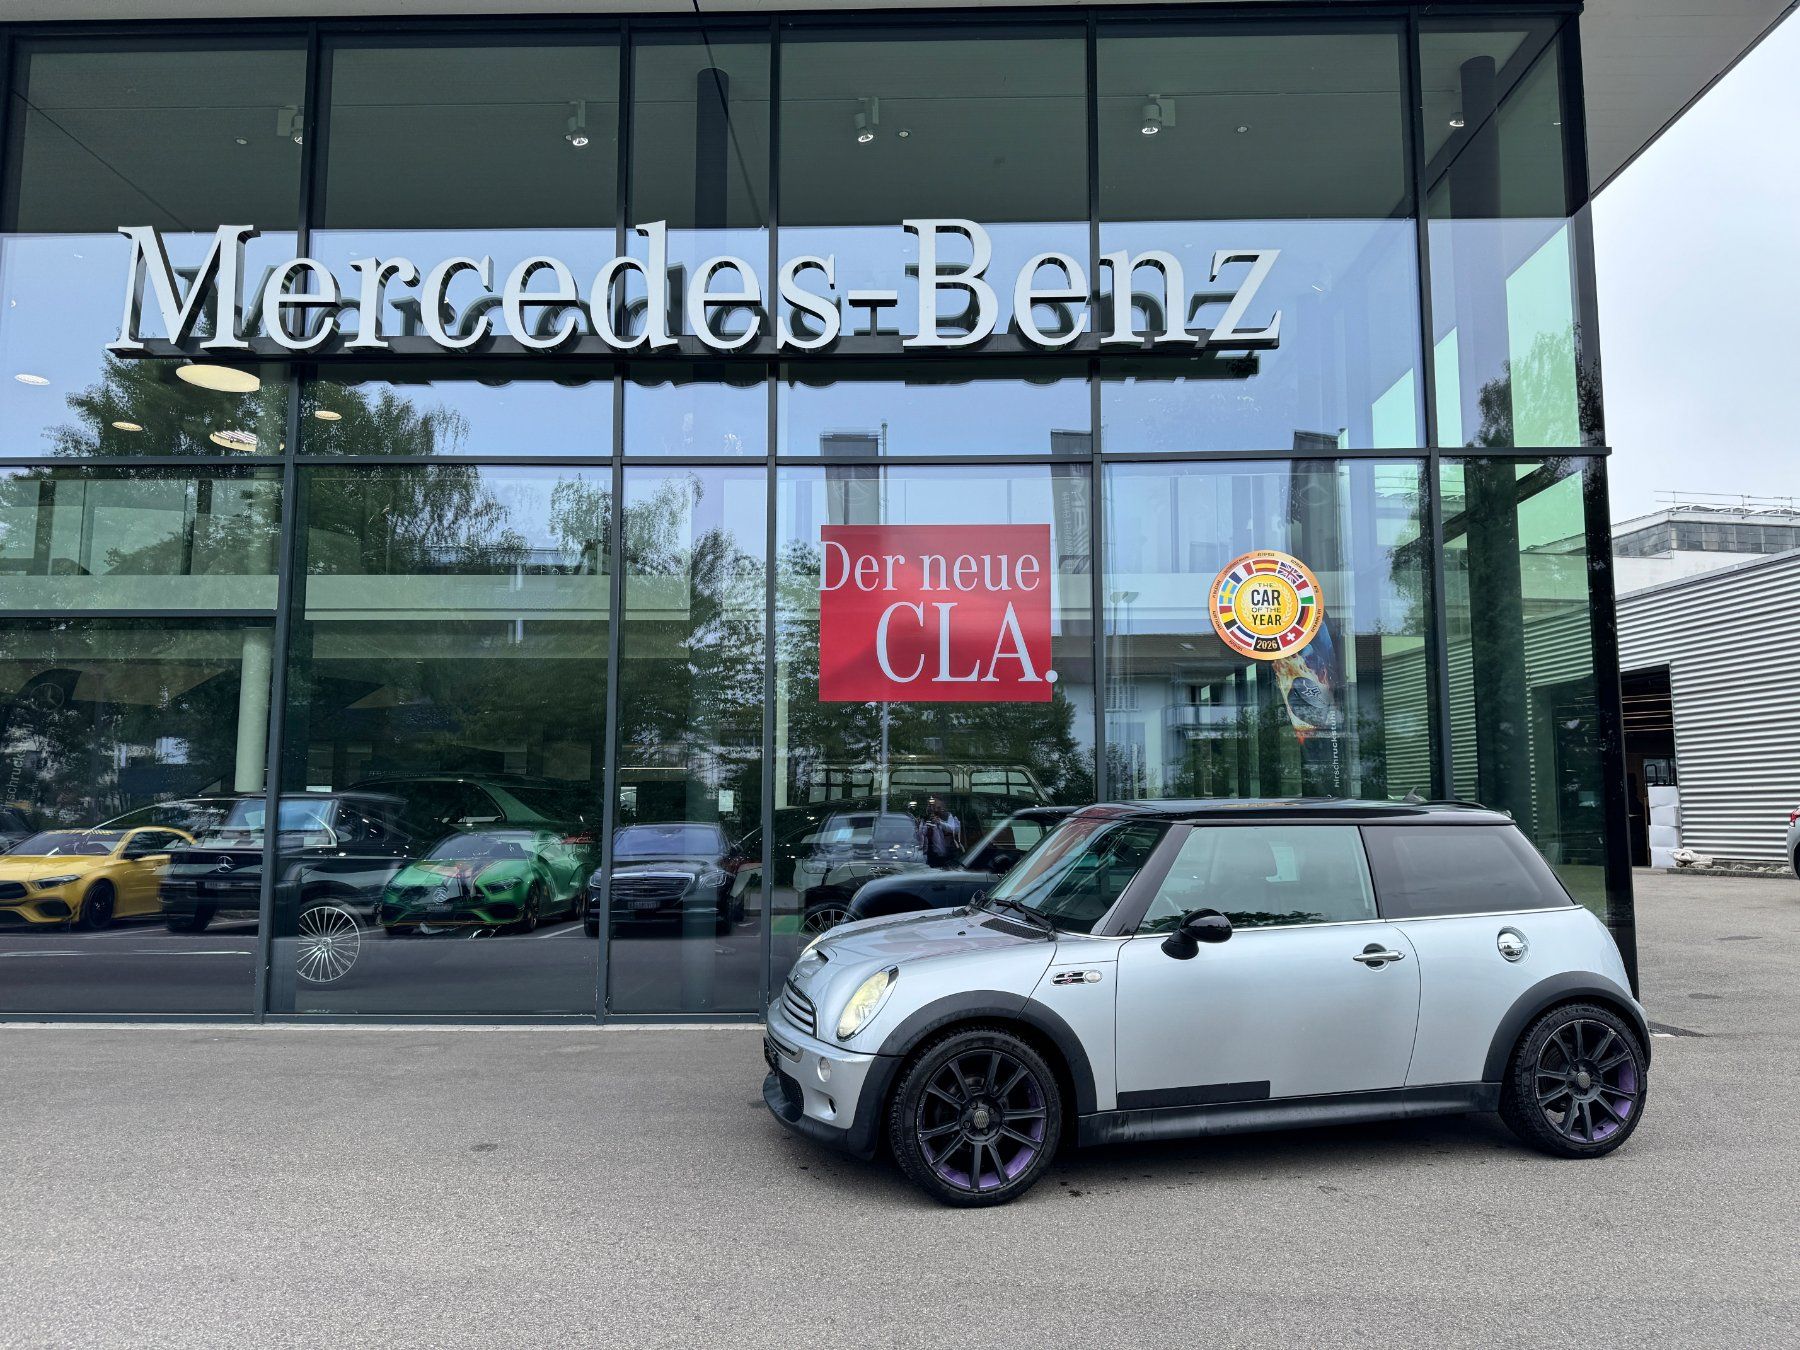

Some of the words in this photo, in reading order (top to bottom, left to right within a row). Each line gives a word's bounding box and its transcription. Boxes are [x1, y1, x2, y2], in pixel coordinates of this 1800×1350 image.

[106, 218, 1282, 352] Mercedes-Benz
[815, 541, 905, 591] Der
[919, 554, 1040, 591] neue
[1251, 589, 1281, 606] CAR
[1252, 614, 1282, 626] YEAR
[876, 601, 1059, 683] CLA.
[1256, 640, 1278, 650] 2026
